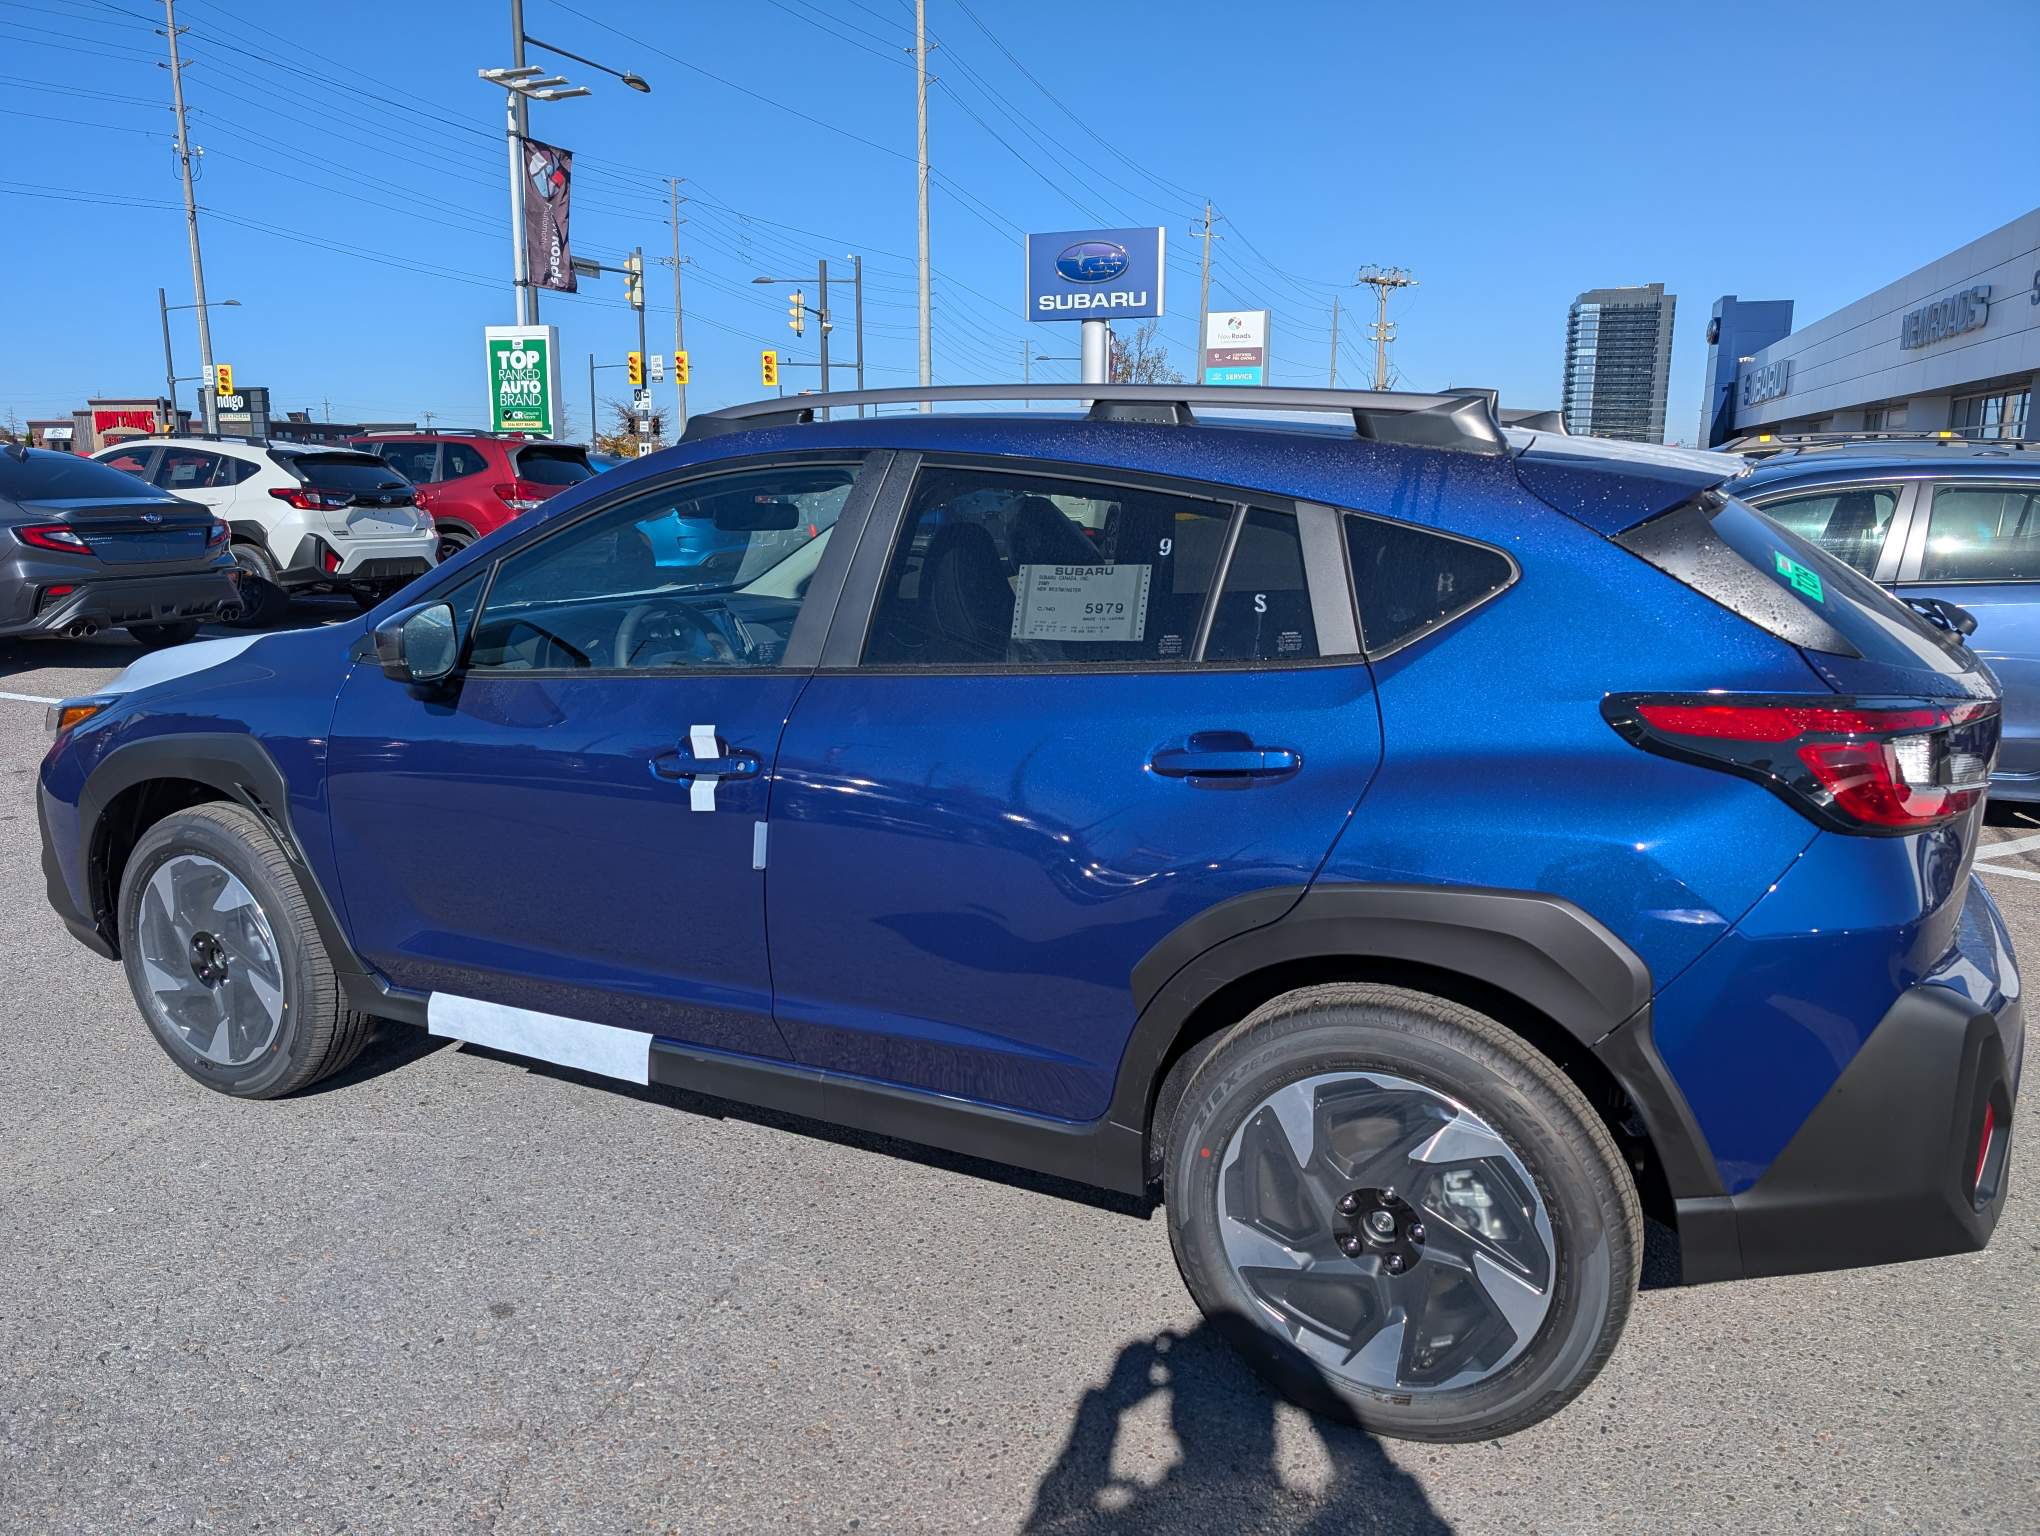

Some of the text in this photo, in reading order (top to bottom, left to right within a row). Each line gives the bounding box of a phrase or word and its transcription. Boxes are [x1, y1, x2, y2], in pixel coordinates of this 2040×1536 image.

[1038, 291, 1147, 311] SUBARU
[497, 350, 540, 370] TOP
[498, 369, 541, 381] RANKED
[1225, 373, 1253, 381] SERVICE
[500, 380, 541, 394] AUTO
[1744, 360, 1790, 406] SUBARU
[216, 394, 244, 411] ndigo
[500, 393, 542, 406] BRAND
[1158, 537, 1172, 556] 9
[1055, 566, 1115, 576] SUBARU
[1084, 602, 1125, 614] 5979
